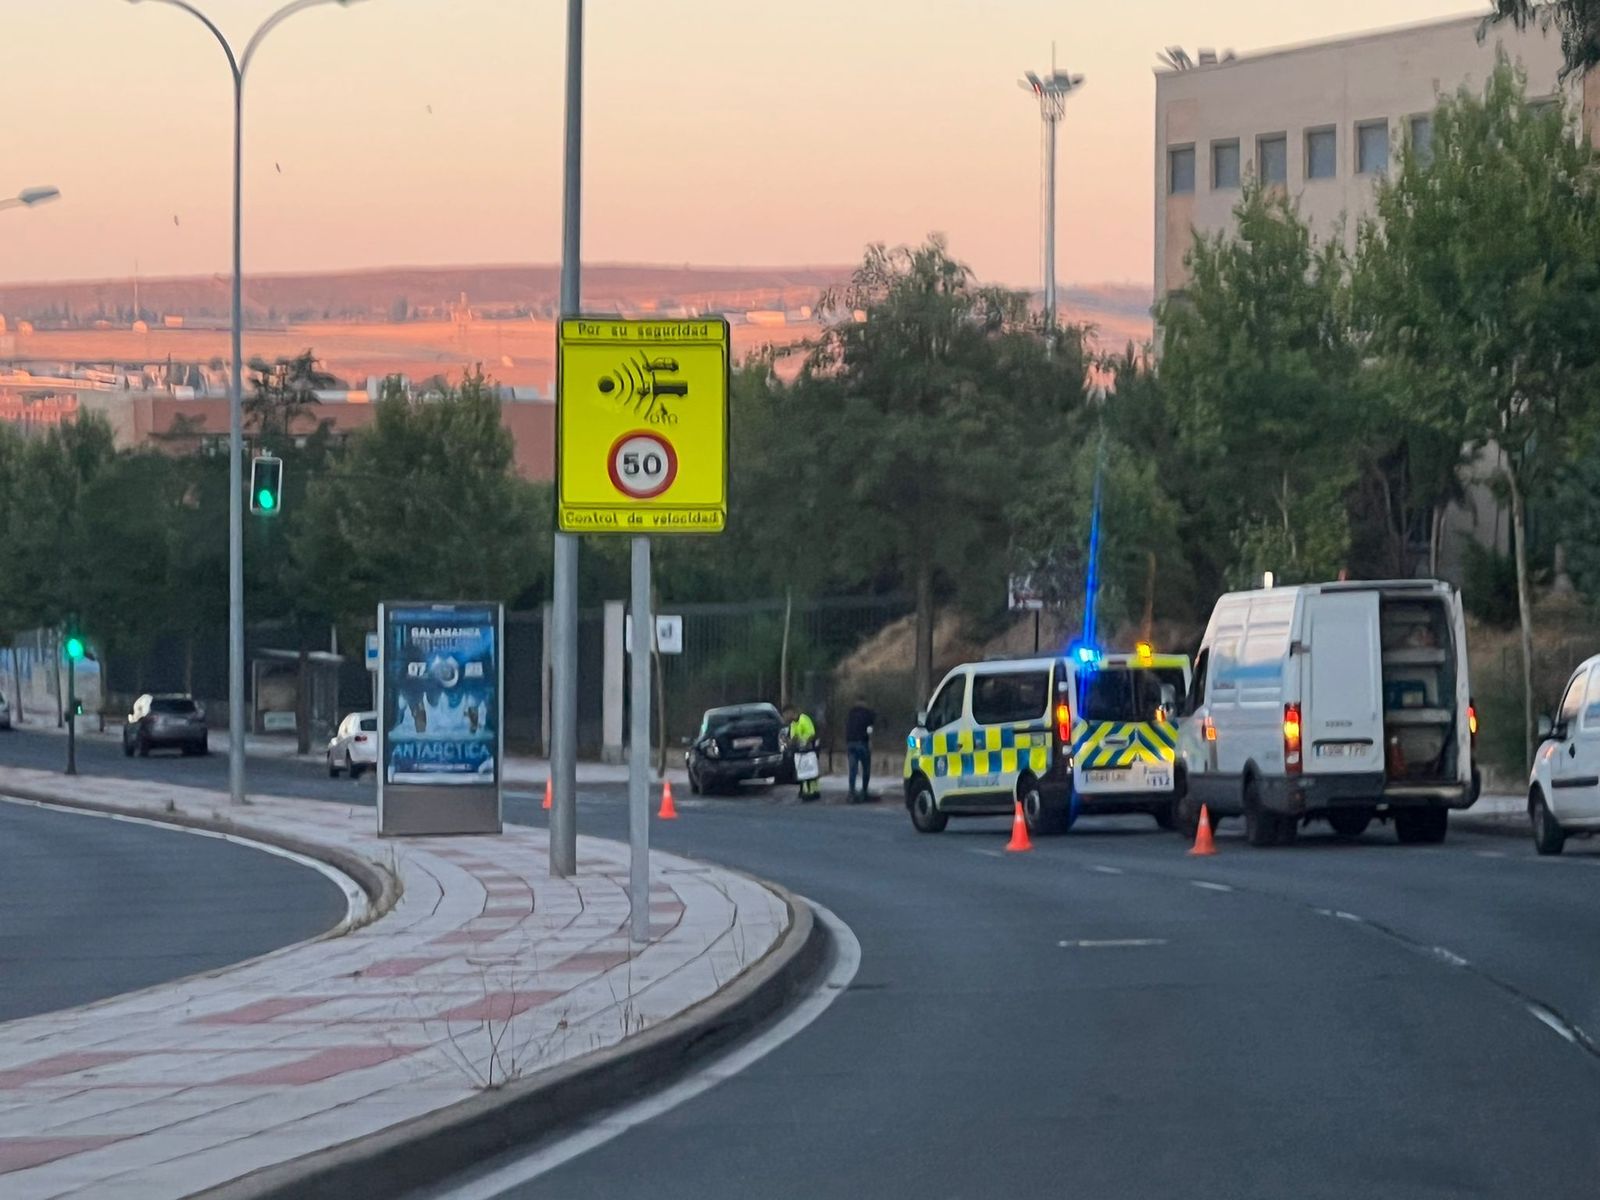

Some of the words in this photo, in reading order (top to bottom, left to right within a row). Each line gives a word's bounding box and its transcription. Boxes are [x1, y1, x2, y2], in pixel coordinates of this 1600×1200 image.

[577, 323, 600, 335] Por
[612, 325, 628, 336] su
[638, 324, 708, 339] seguridad
[623, 453, 662, 475] 50
[565, 511, 617, 524] Control
[627, 511, 643, 524] de
[652, 511, 717, 525] velocidad
[392, 742, 491, 760] ANTARCTICA
